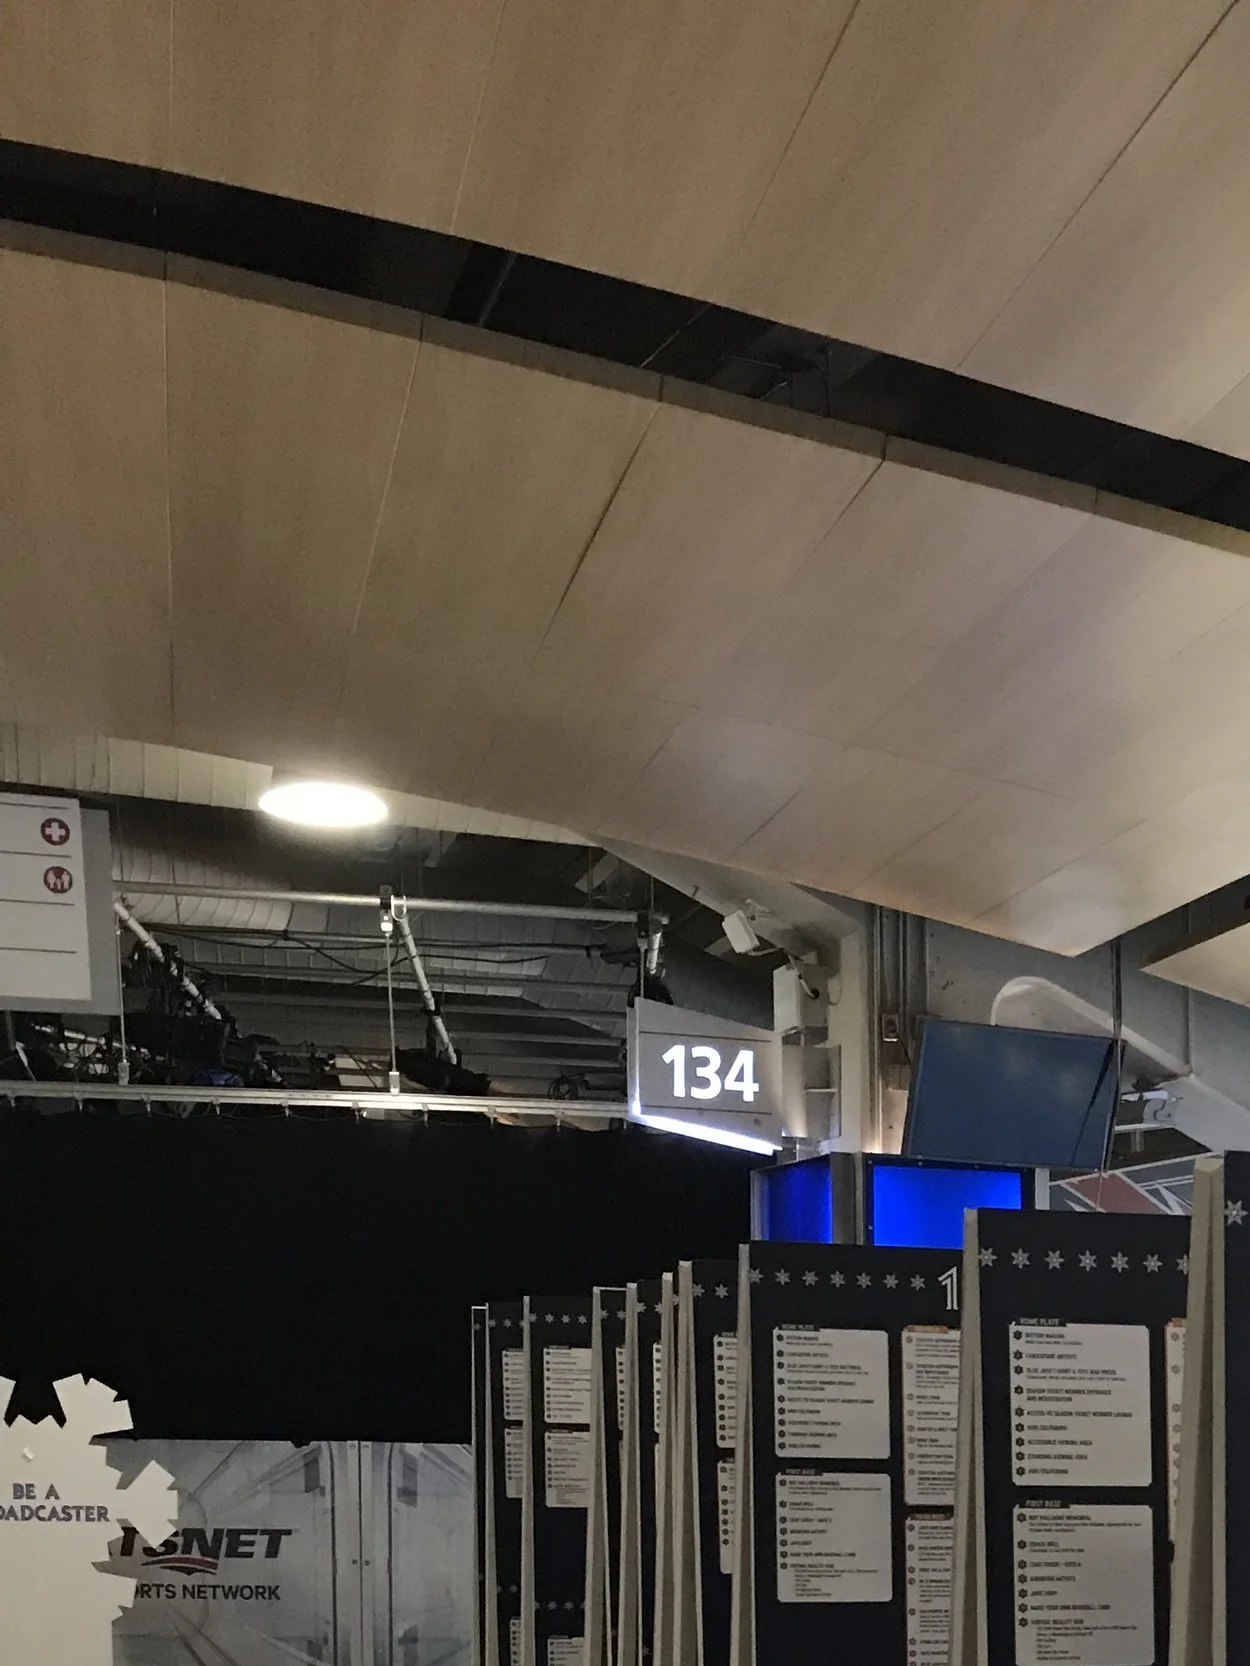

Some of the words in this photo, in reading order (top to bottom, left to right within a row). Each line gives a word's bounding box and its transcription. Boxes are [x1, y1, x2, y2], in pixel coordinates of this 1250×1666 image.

[661, 1044, 760, 1103] 134
[12, 1483, 36, 1500] BE
[45, 1484, 60, 1500] A
[134, 1584, 176, 1600] RTS
[182, 1584, 281, 1600] NETWORK
